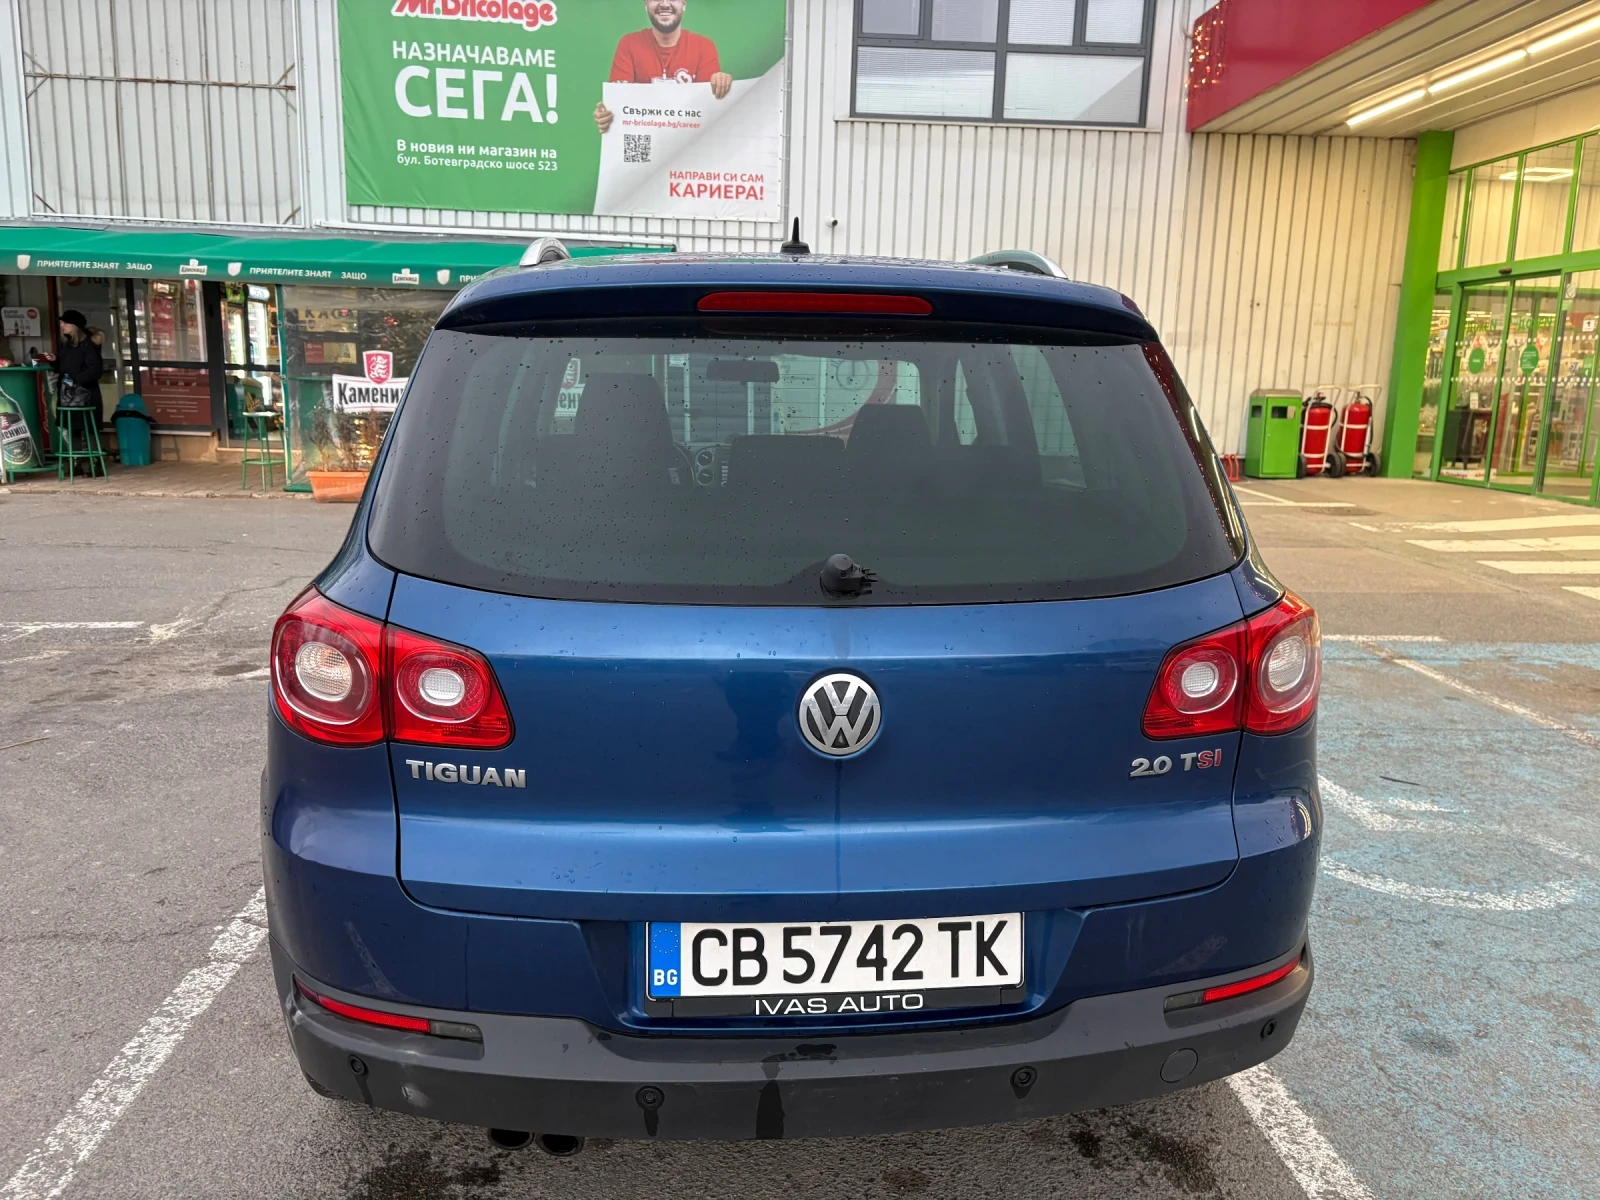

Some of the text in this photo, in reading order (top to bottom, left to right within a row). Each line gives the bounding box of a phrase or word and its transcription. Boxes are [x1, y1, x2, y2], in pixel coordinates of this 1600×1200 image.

[392, 40, 557, 68] НАЗНАЧАВАМЕ
[394, 65, 559, 124] СЕГА!
[622, 105, 662, 119] Свържи
[664, 108, 675, 117] се
[685, 110, 702, 118] нас
[622, 119, 701, 129] mr-bricolage.bg/career
[396, 139, 557, 159] В новия ни магазин на
[397, 153, 558, 171] бул. Ботевградско шосе 523
[669, 170, 764, 183] НАПРАВИ СИ САМ
[669, 182, 764, 201] КАРИЕРА!
[37, 260, 153, 271] ПРИЯТЕЛИТЕ ЗНАЯТ ЗАЩО
[249, 267, 368, 281] ПРИЯТЕЛИТЕ ЗНАЯТ ЗАЩО
[337, 382, 404, 406] Камени
[1180, 748, 1222, 772] TSI
[405, 759, 527, 788] TIGUAN
[691, 919, 1009, 987] CB 5742 TK
[653, 968, 678, 986] BG
[754, 993, 924, 1016] IVAS AUTO
